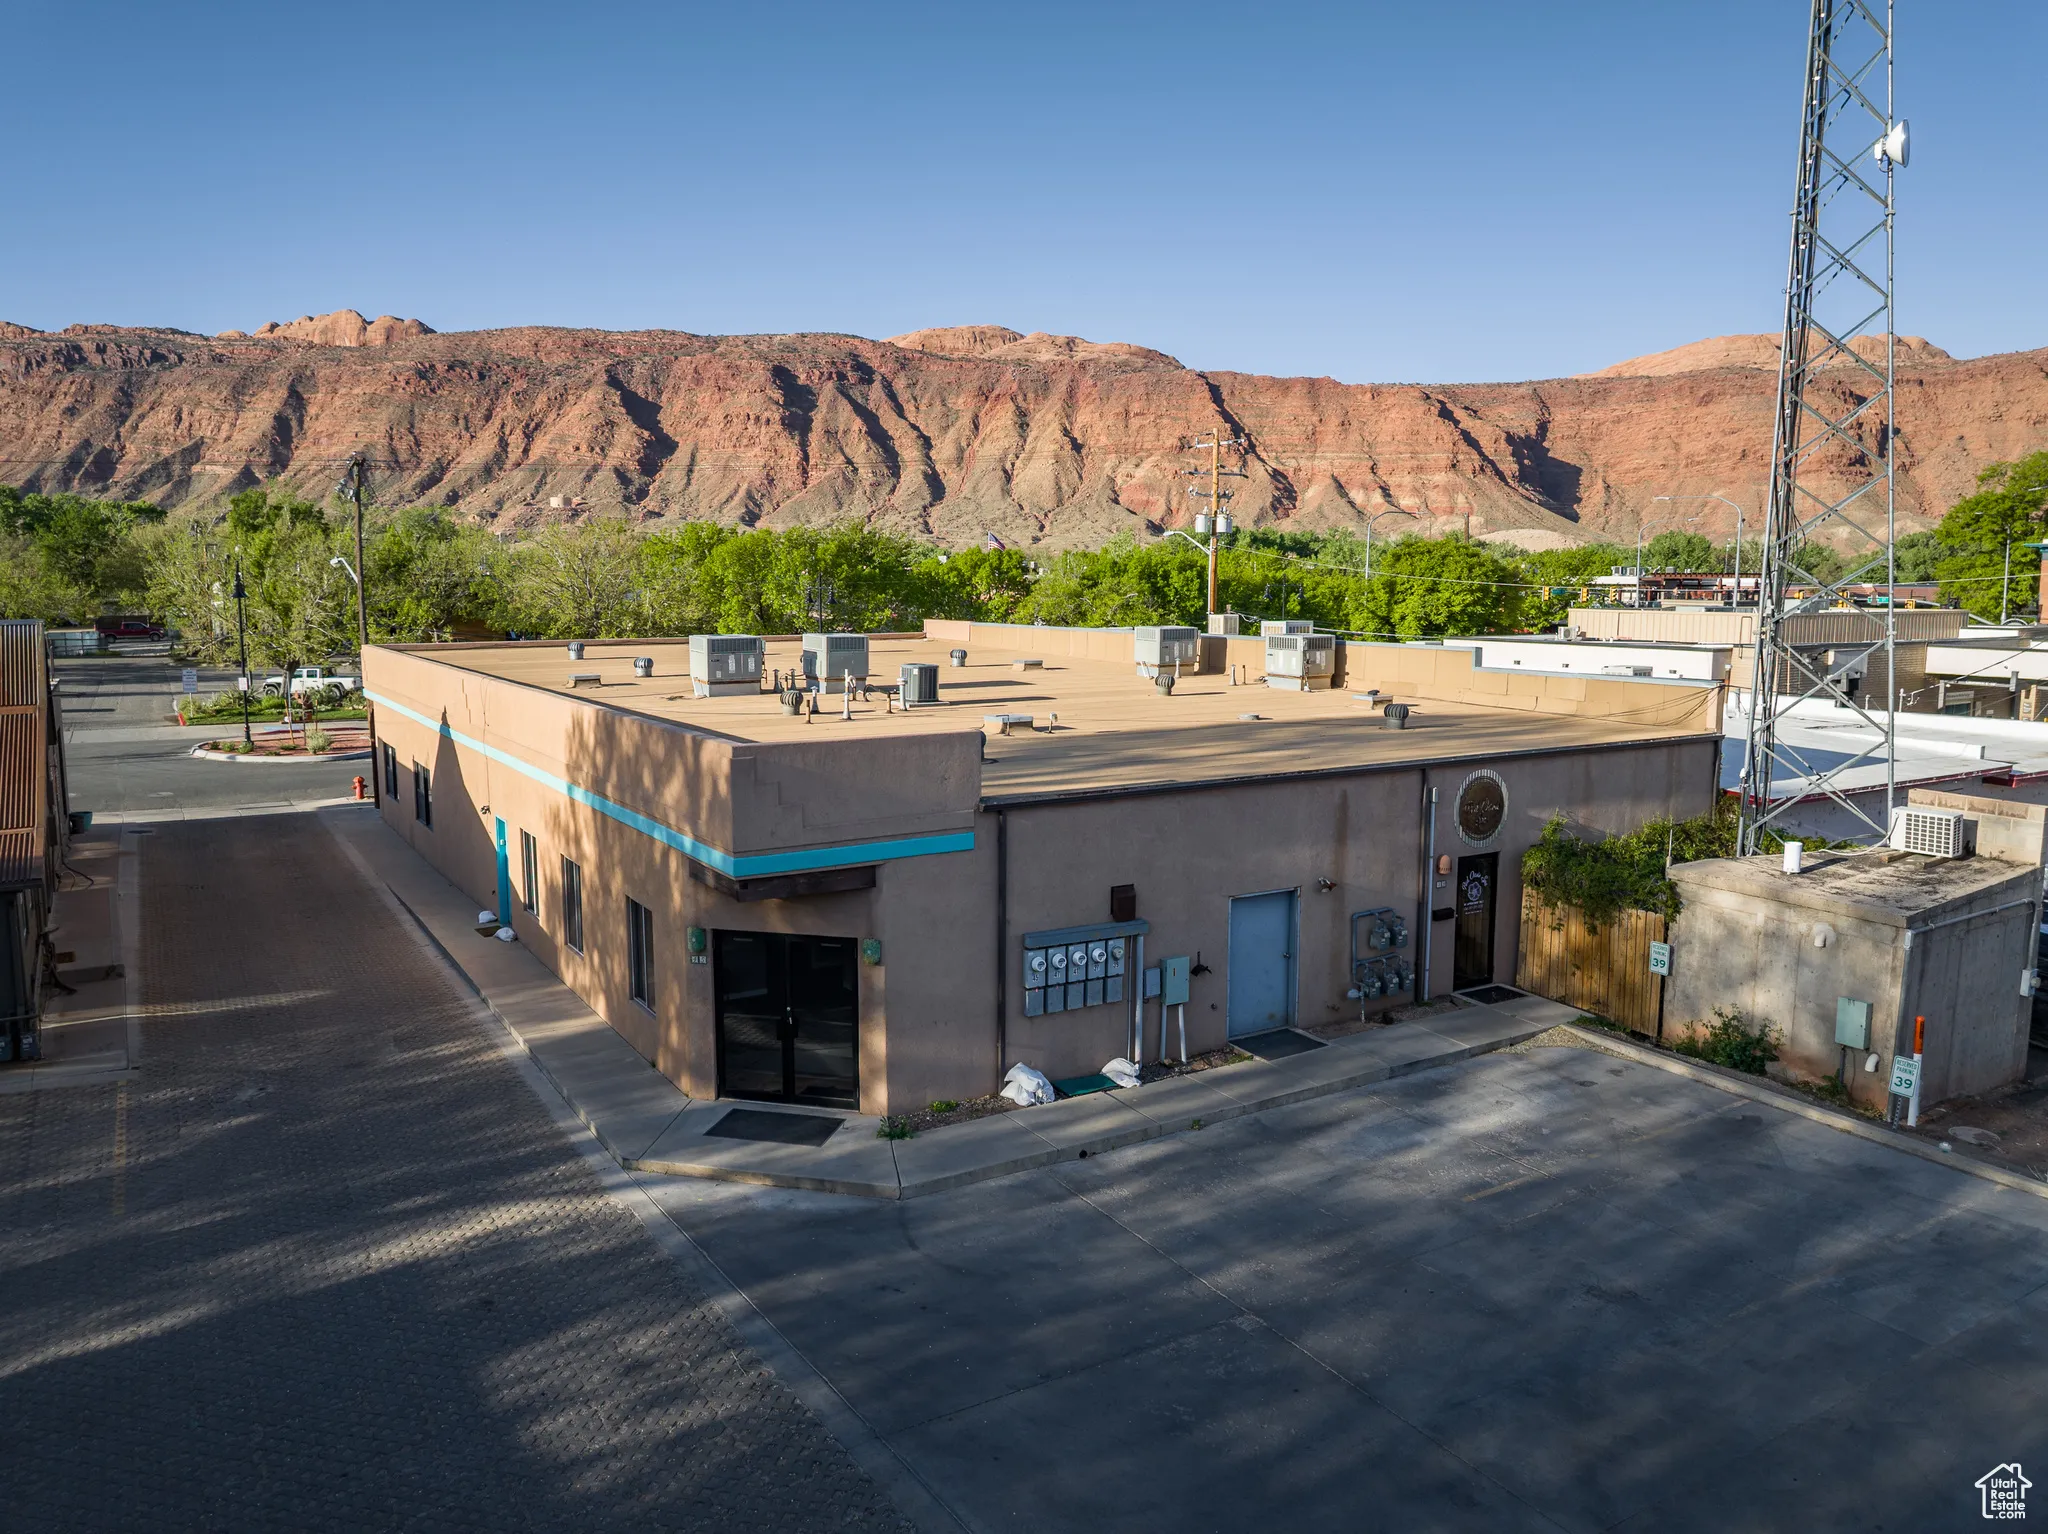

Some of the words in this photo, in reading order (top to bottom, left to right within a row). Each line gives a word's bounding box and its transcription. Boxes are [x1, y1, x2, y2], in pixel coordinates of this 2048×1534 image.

[1652, 957, 1666, 968] 39
[1896, 1059, 1918, 1070] RESERVED
[1896, 1066, 1915, 1076] PARKING
[1894, 1076, 1913, 1089] 39
